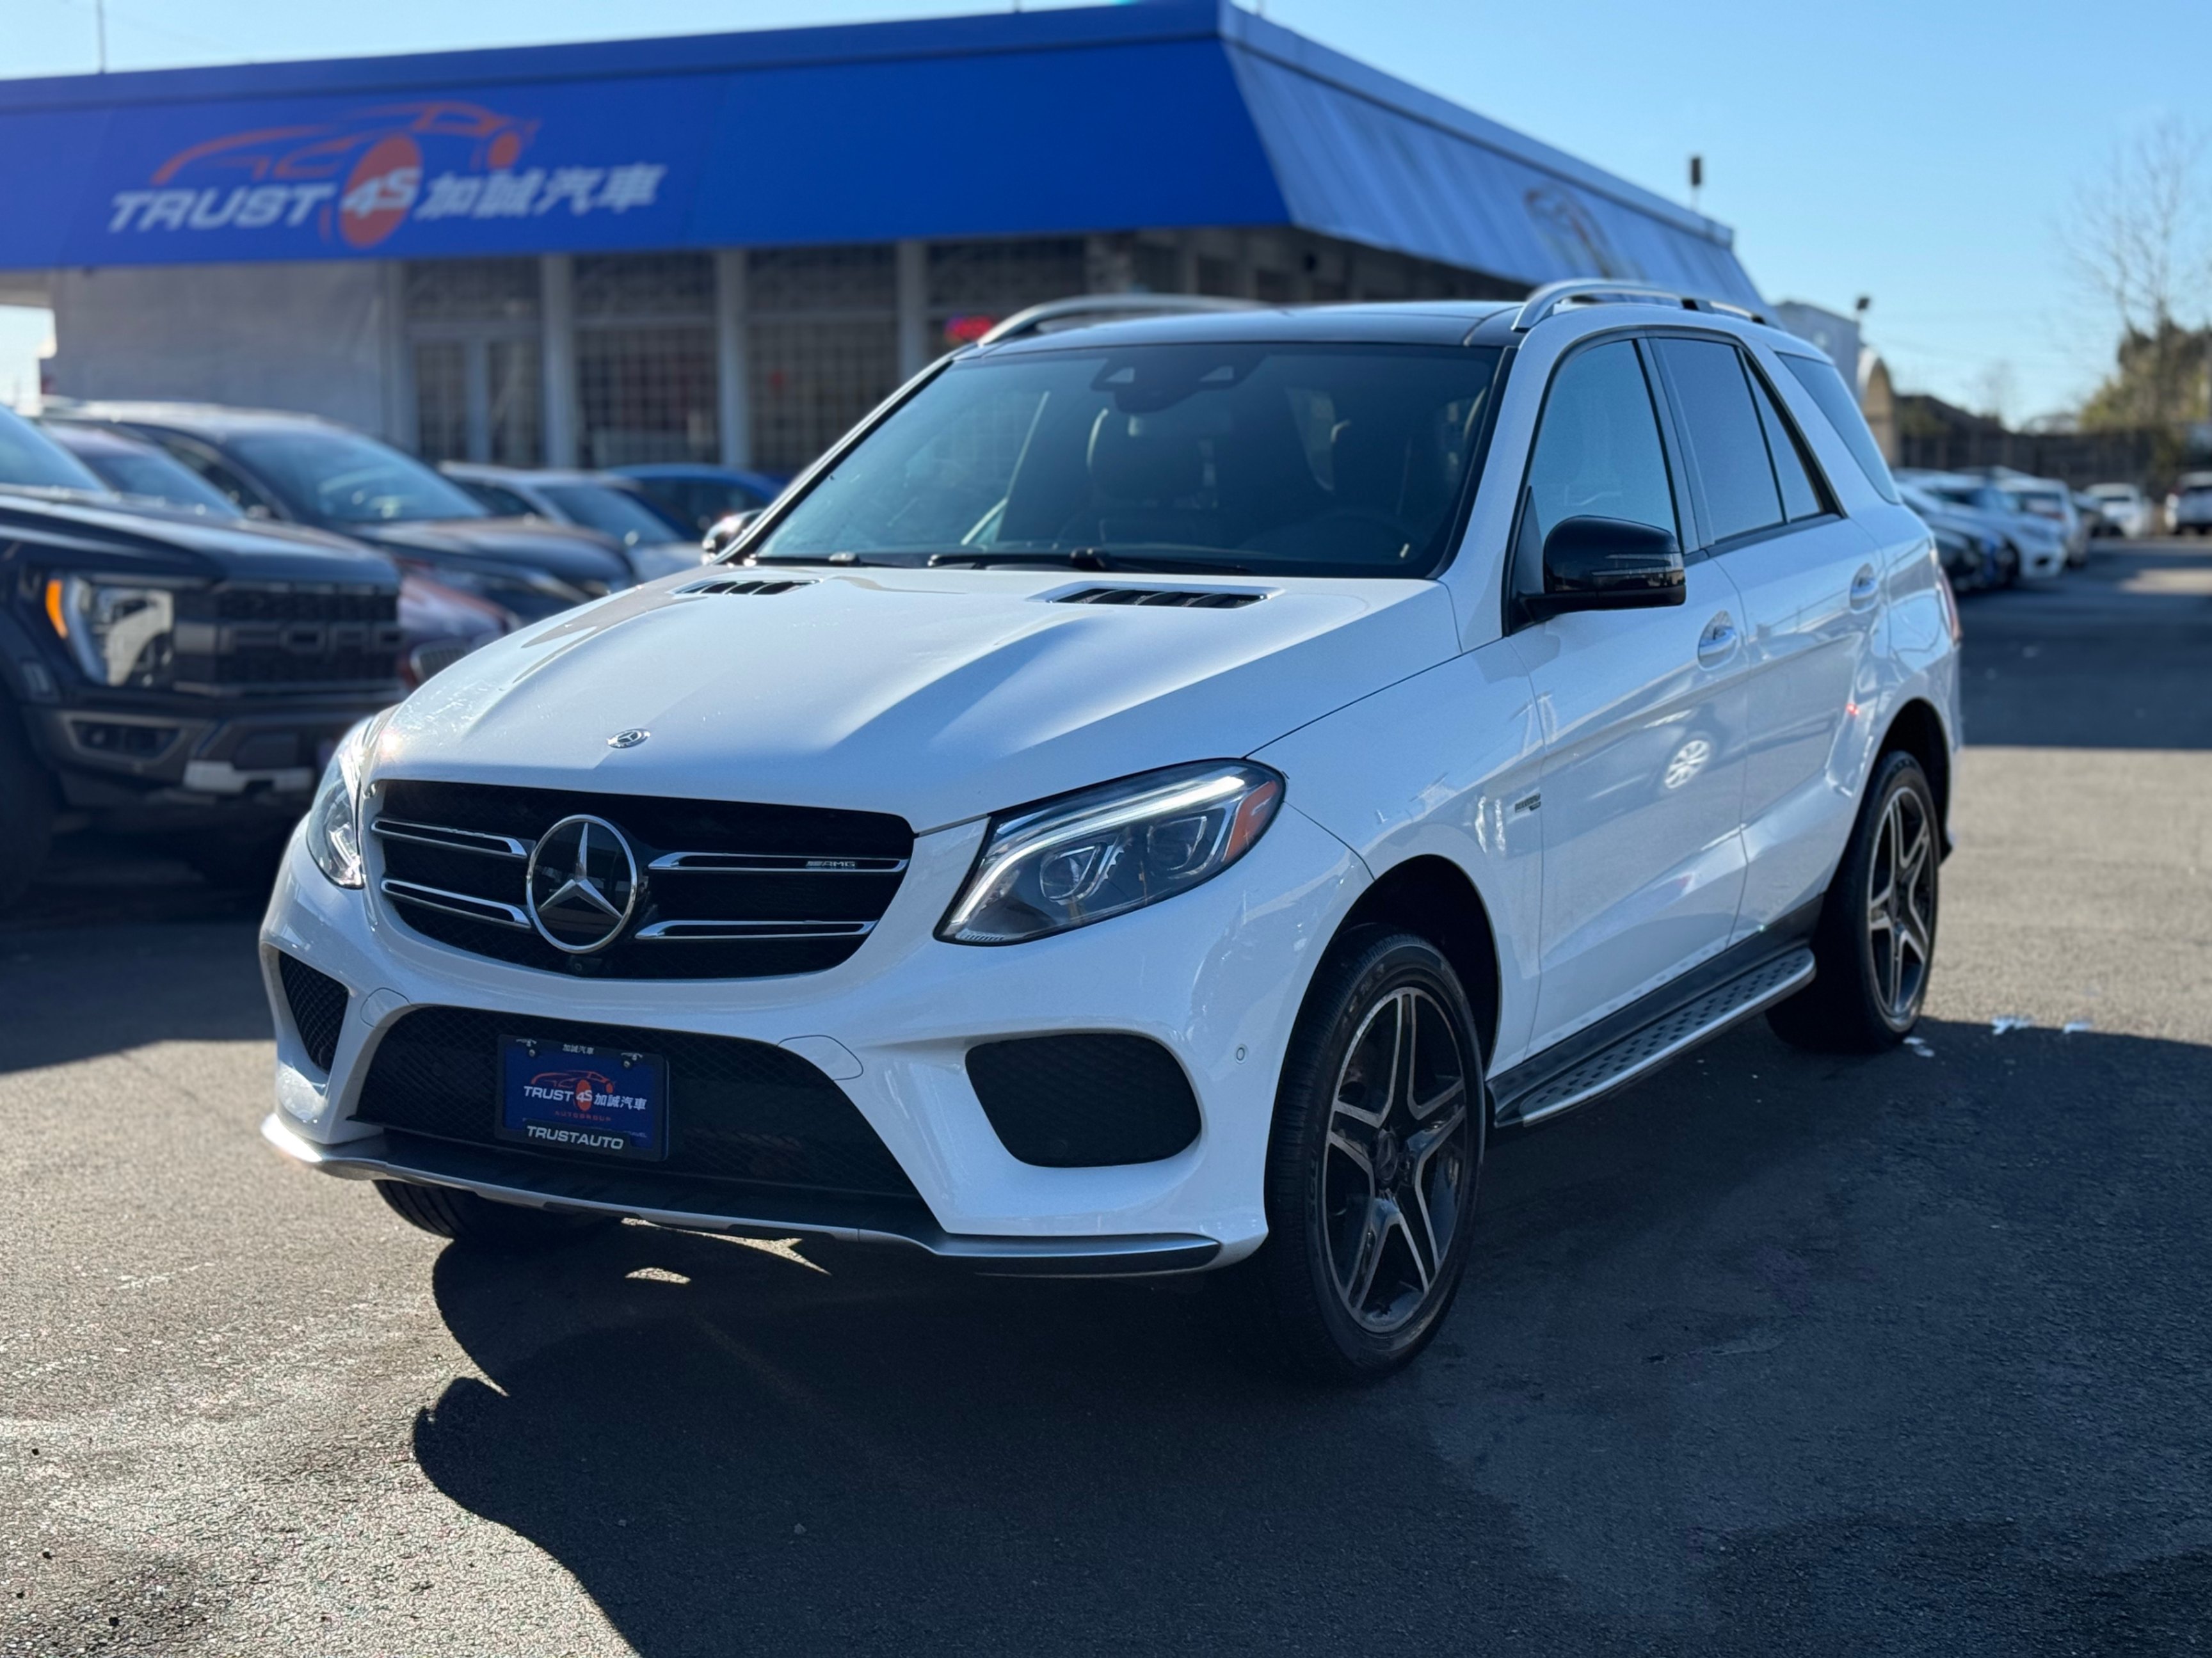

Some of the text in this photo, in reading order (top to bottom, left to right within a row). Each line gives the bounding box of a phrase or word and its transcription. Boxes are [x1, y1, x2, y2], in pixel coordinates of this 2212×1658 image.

[109, 183, 337, 233] TRUST
[219, 621, 408, 654] FORD
[524, 1086, 648, 1111] TRUST 4S 加誠汽車
[554, 1110, 612, 1122] AUTOGROUP
[526, 1125, 624, 1150] TRUSTAUTO
